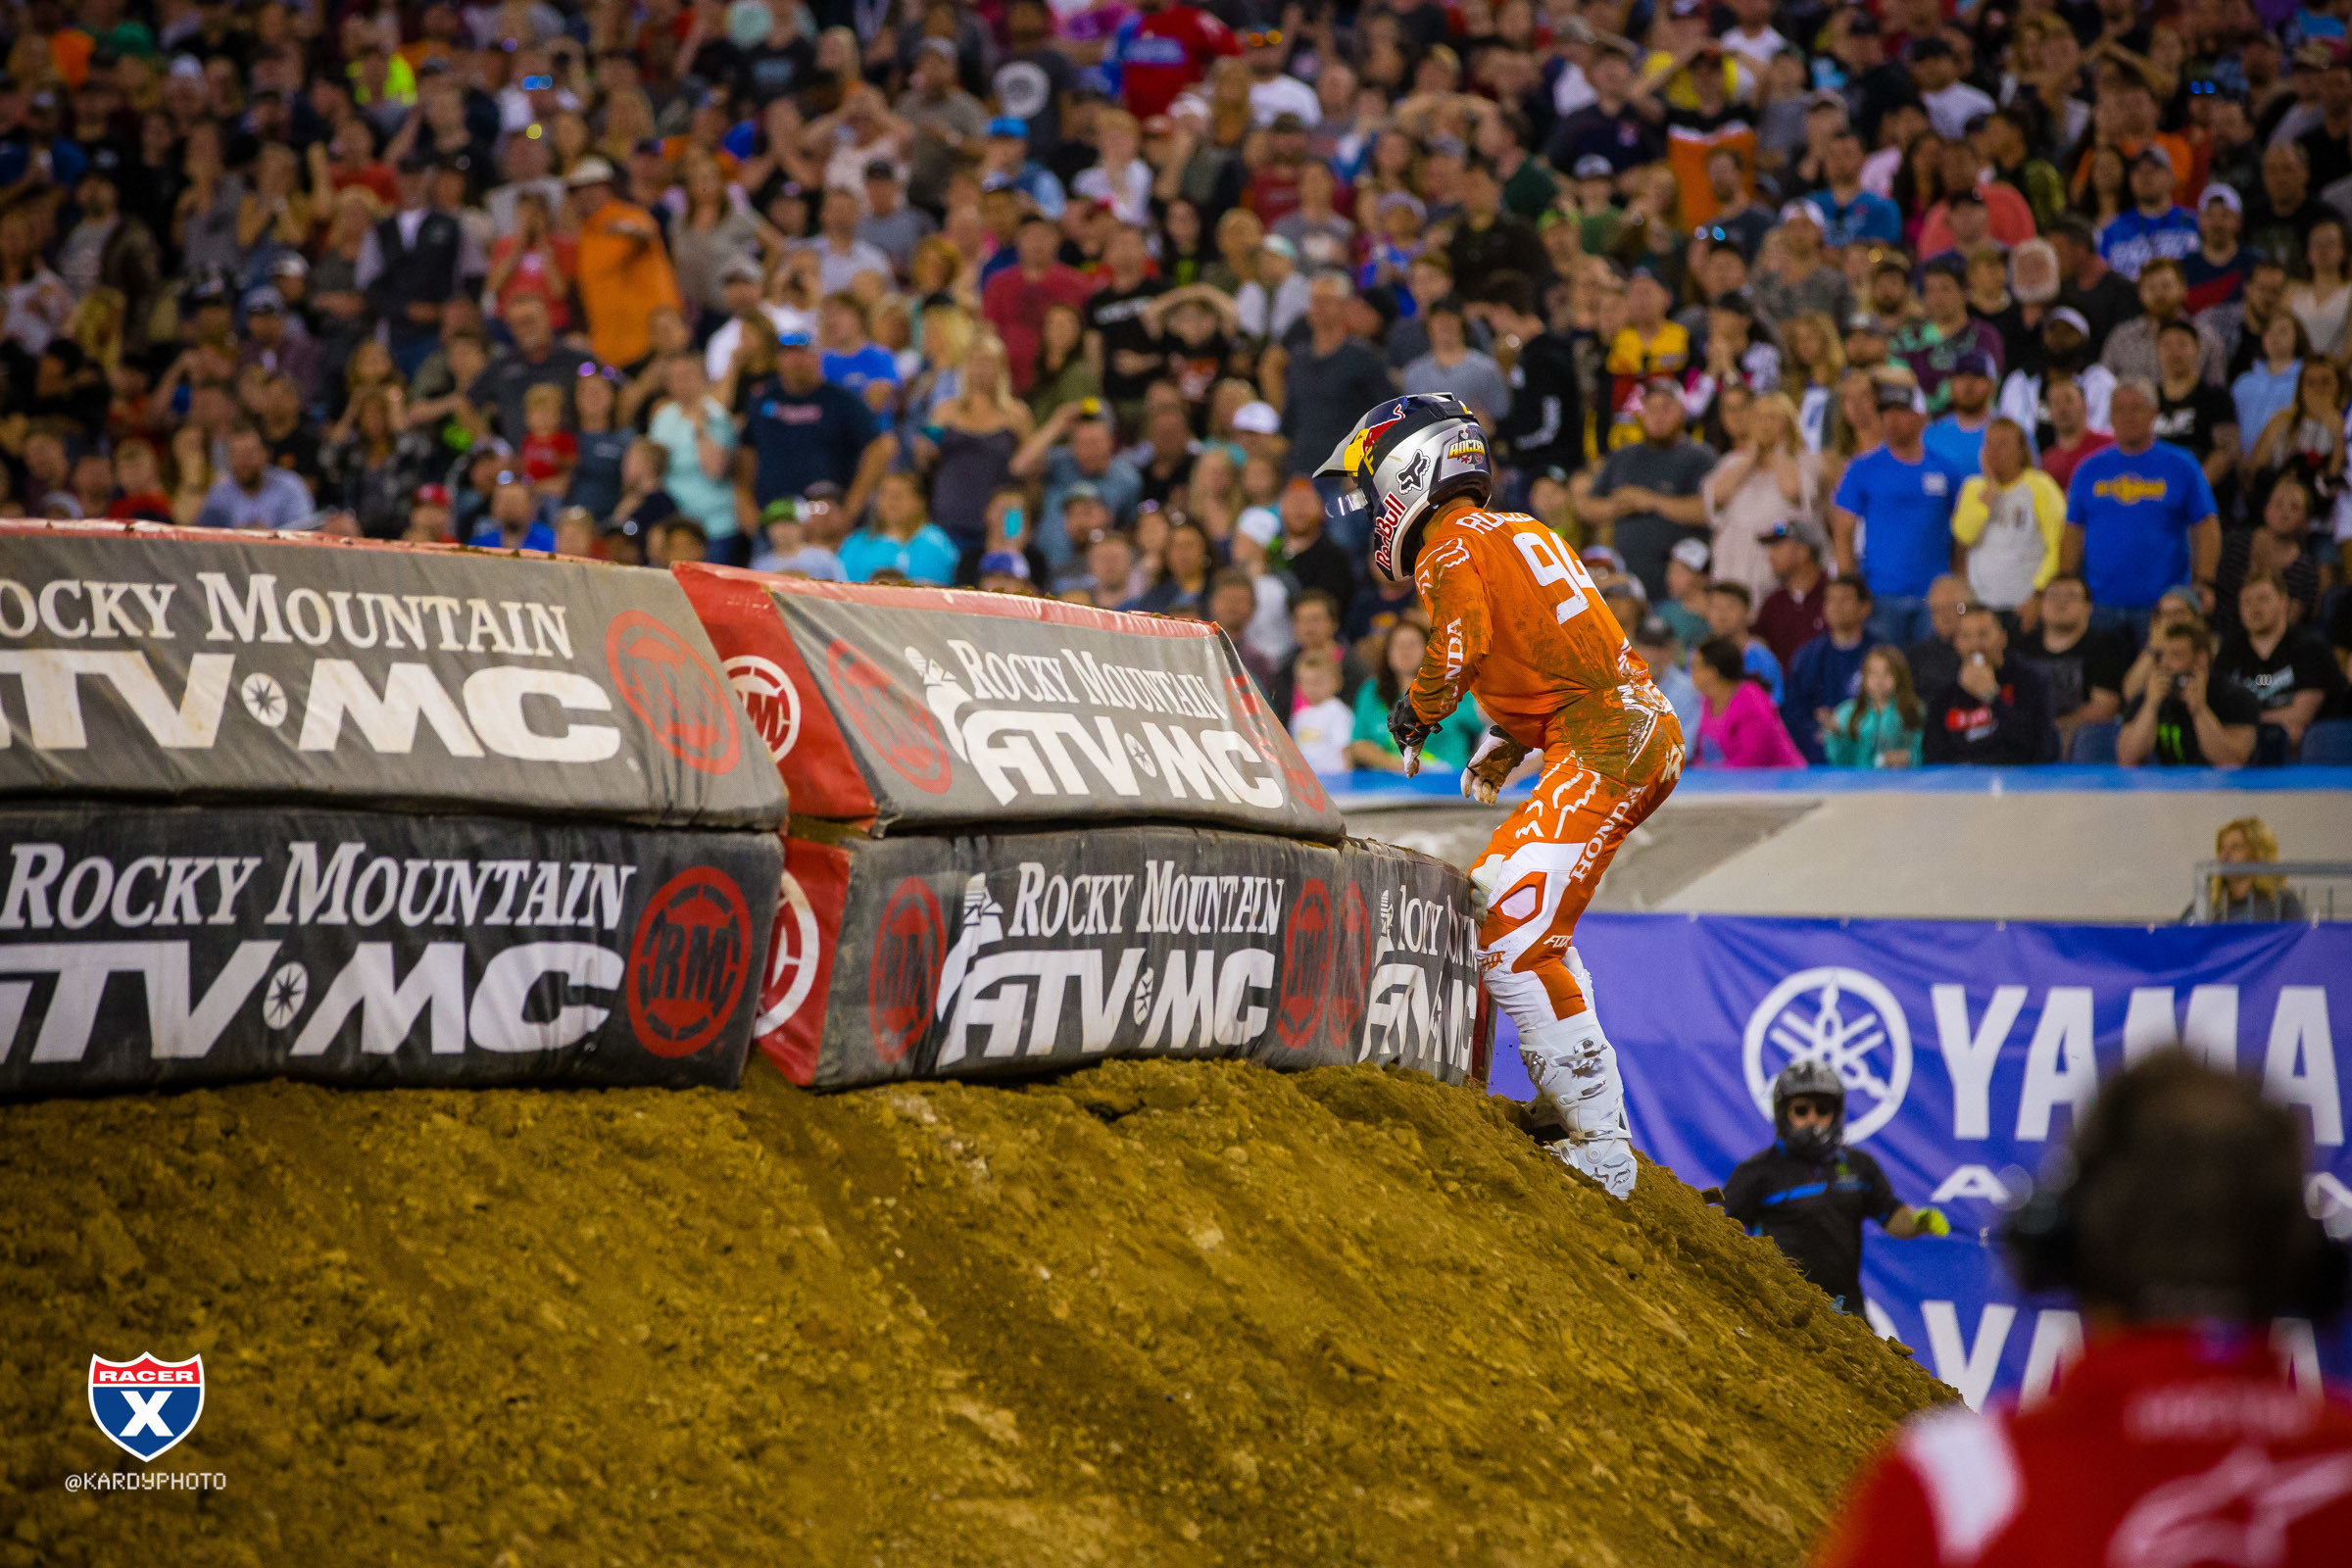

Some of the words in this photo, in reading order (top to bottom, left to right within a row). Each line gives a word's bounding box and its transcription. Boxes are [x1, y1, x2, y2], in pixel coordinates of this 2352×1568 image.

[1376, 491, 1407, 541] Bull
[197, 572, 574, 660] MOUNTAIN
[0, 649, 236, 750] TV
[947, 639, 1080, 704] ROCKY
[1060, 648, 1228, 720] MOUNTAIN
[0, 842, 263, 930] ROCKY
[264, 841, 637, 930] MOUNTAIN
[1007, 861, 1135, 938] ROCKY
[1135, 859, 1285, 936] MOUNTAIN
[0, 940, 283, 1065] TV
